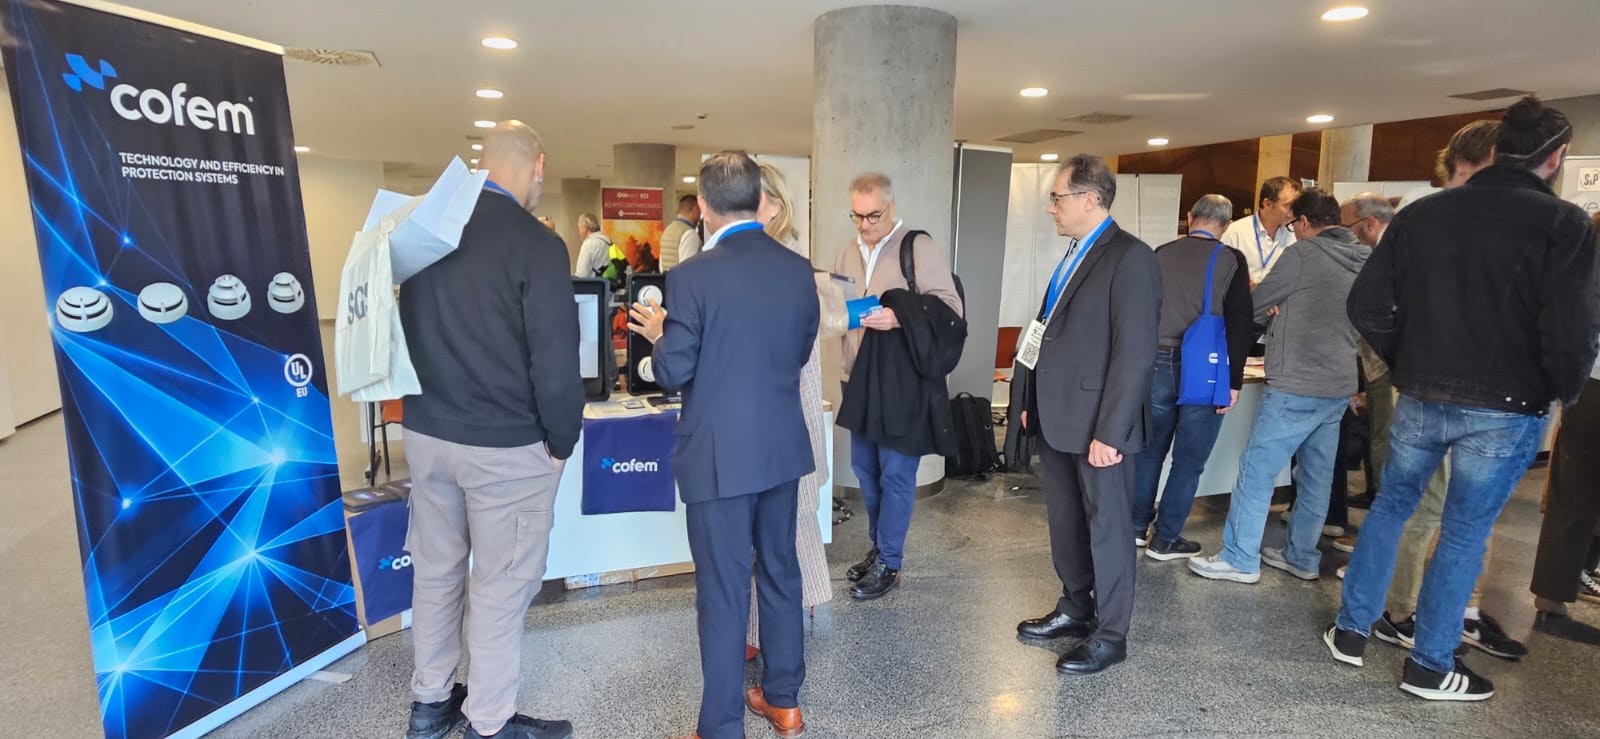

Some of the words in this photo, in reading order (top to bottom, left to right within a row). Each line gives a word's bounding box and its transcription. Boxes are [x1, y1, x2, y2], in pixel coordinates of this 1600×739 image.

[110, 82, 256, 136] cofem
[119, 152, 198, 169] TECHNOLOGY
[199, 159, 221, 171] AND
[222, 161, 275, 176] EFFICIENCY
[274, 166, 285, 176] IN
[121, 166, 194, 182] PROTECTION
[195, 172, 239, 185] SYSTEMS
[291, 361, 307, 380] UL
[296, 386, 308, 398] EU
[612, 458, 659, 474] cofem
